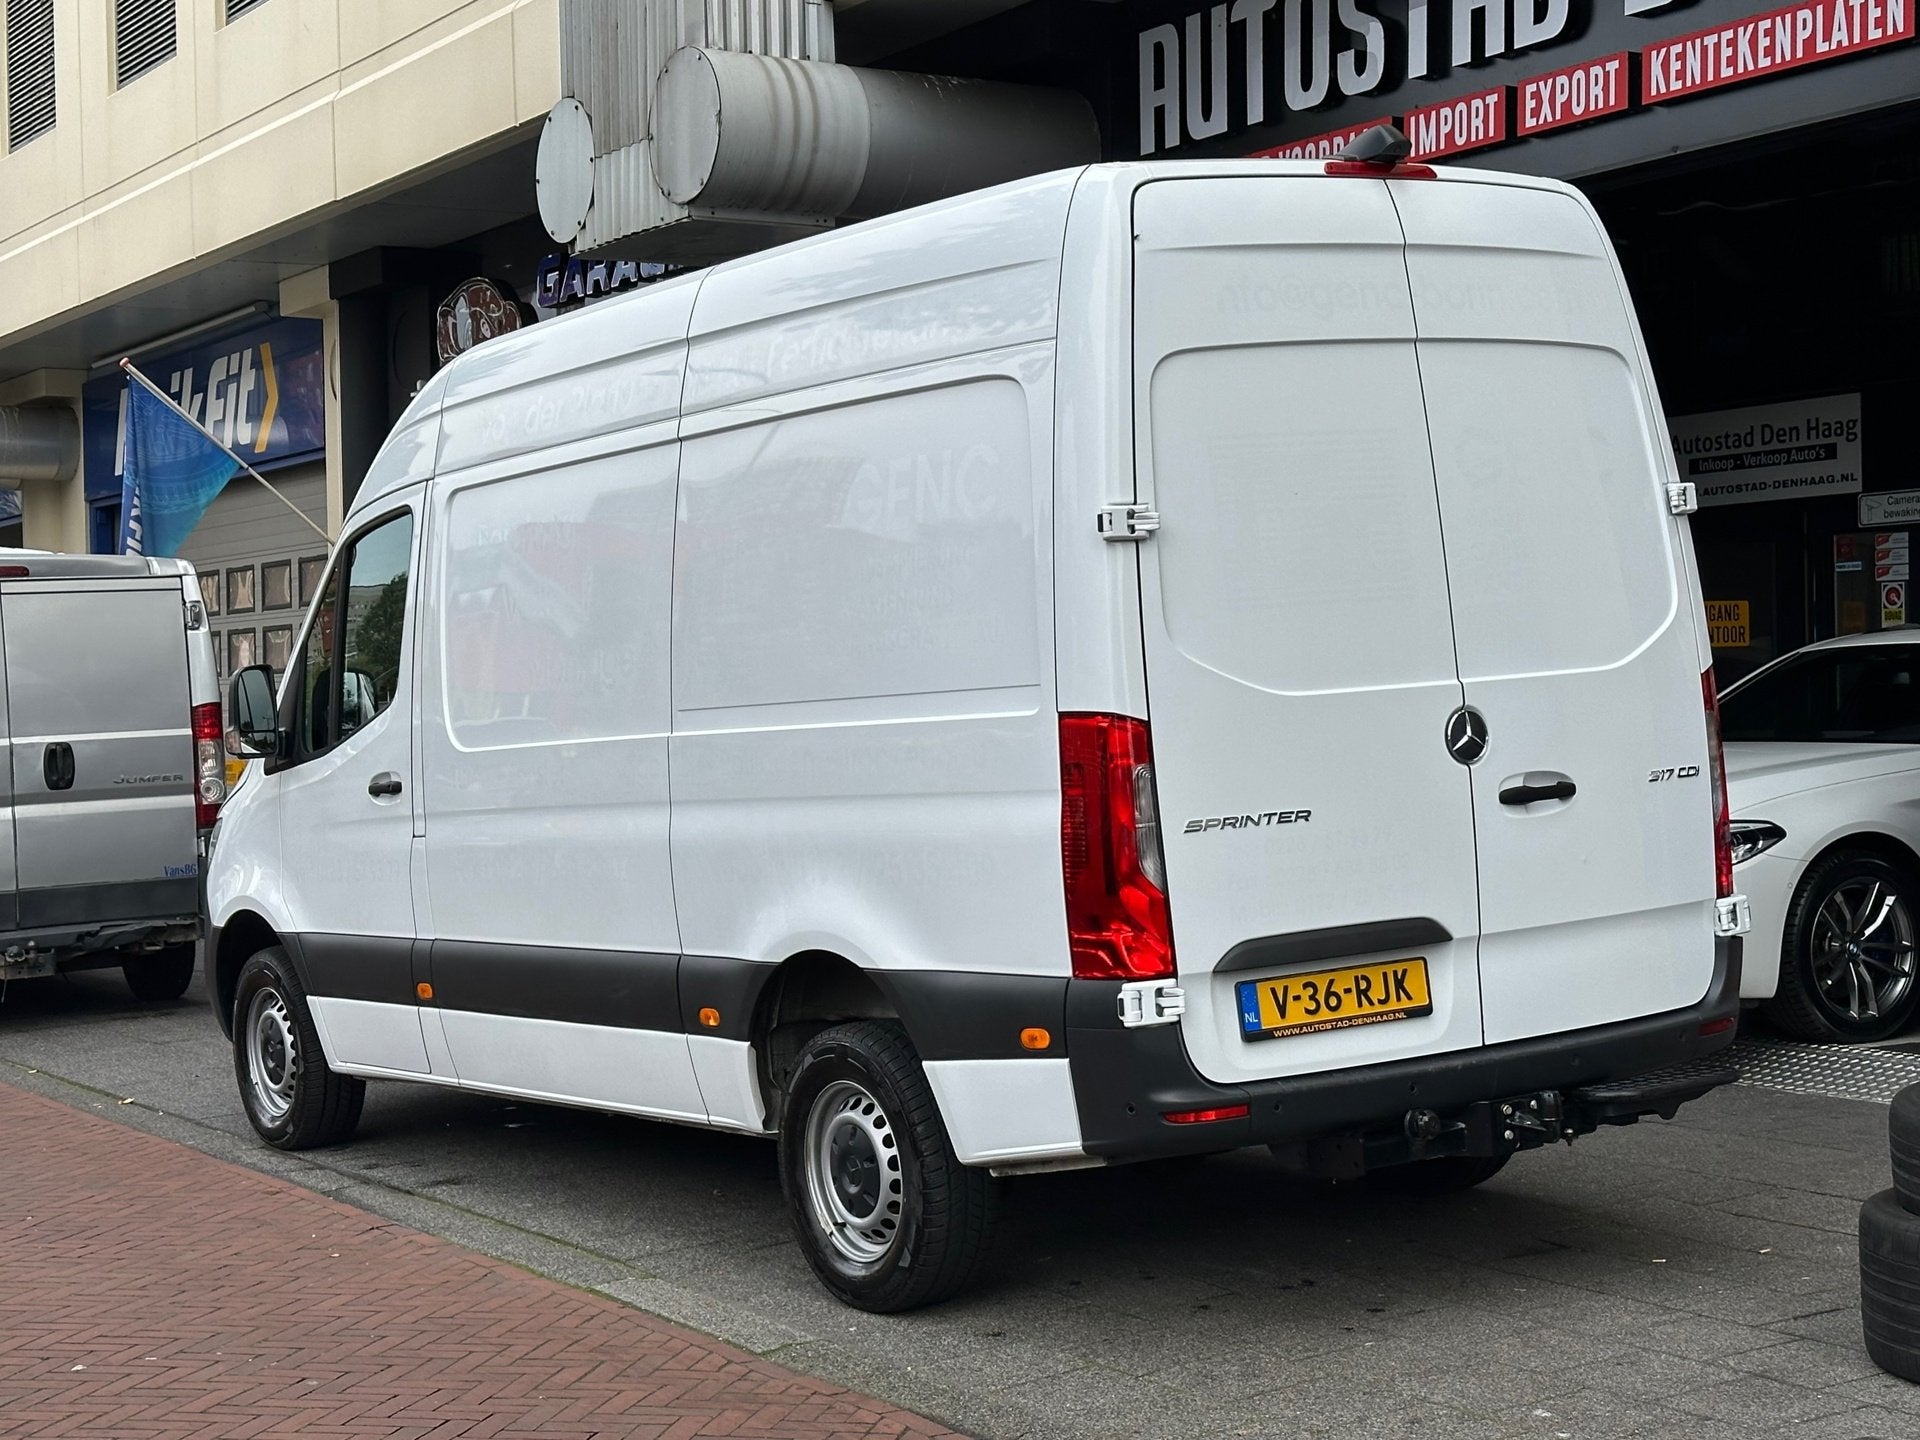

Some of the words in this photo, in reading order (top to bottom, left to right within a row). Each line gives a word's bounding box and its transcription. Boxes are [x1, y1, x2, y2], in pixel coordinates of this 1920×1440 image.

[1139, 0, 1566, 156] AUTOST
[1410, 93, 1499, 158] IMPORT
[1525, 58, 1620, 129] EXPORT
[1650, 0, 1905, 97] KENTEKENPLATEN
[1672, 425, 1754, 455] Autostad
[1761, 423, 1800, 446] Den
[1806, 417, 1858, 442] Haag
[1699, 458, 1735, 472] Inkoop
[1743, 451, 1788, 467] Verkoop
[1790, 446, 1826, 462] Auto's
[1696, 472, 1858, 497] .AUTOSTAD-DENHAAG.NL
[113, 773, 184, 784] JUMPER
[1648, 768, 1675, 782] 317
[1183, 809, 1312, 834] SPRINTER
[1270, 968, 1413, 1020] V-36-RJK
[1244, 1012, 1258, 1023] NL
